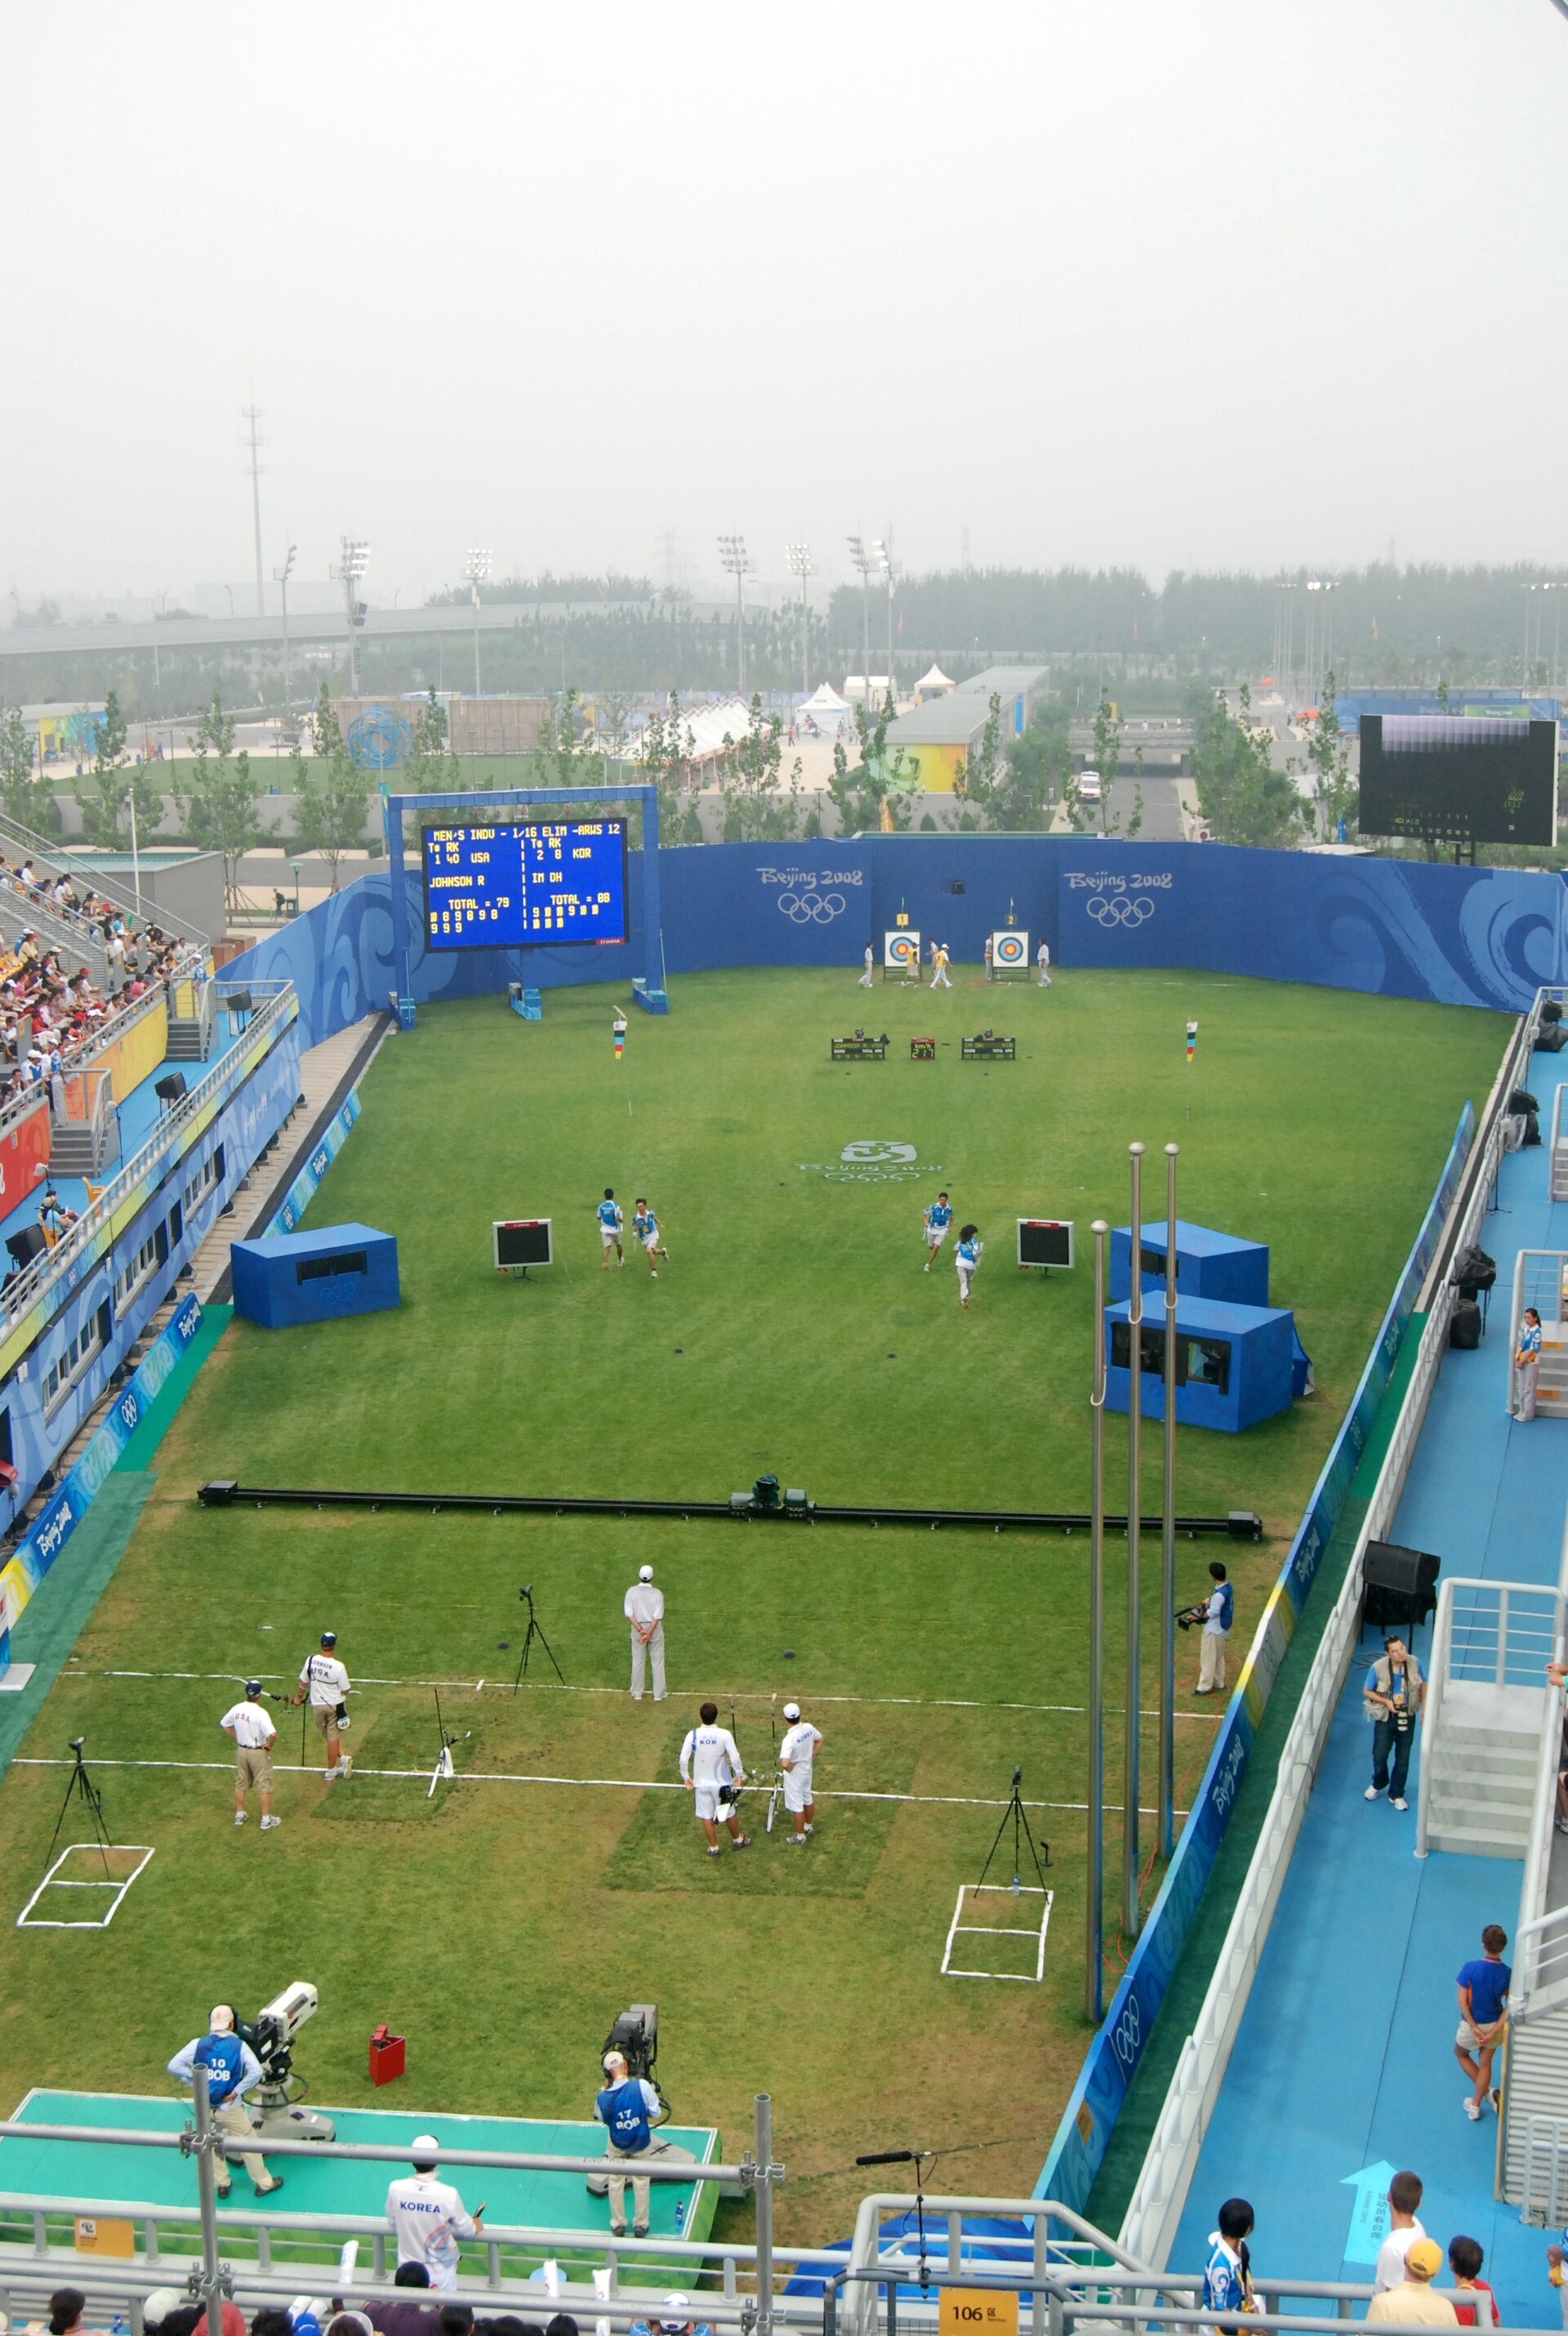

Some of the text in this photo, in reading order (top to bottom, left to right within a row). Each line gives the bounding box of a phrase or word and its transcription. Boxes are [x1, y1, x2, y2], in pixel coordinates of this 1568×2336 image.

[434, 830, 465, 840] MEN'S
[513, 827, 537, 838] 1/16
[542, 826, 567, 836] ELIM
[608, 823, 620, 834] 12
[446, 841, 459, 852] RK
[549, 837, 561, 848] RK
[435, 852, 490, 864] 1 40 USA
[537, 849, 544, 860] 2
[572, 847, 591, 858] KOR
[430, 875, 485, 888] JOHNSON R
[532, 872, 563, 883] IM DH
[755, 867, 863, 889] Beijing 2008
[1062, 871, 1173, 893] Beijing 2008
[448, 898, 479, 910] TOTAL
[497, 897, 510, 907] 79
[550, 894, 580, 905] TOTAL
[597, 892, 610, 903] 88
[455, 910, 462, 921] 9
[479, 909, 486, 921] 9
[532, 907, 540, 917] 9
[568, 905, 576, 916] 9
[1008, 915, 1014, 925] 2
[430, 921, 463, 934] 9 9 9
[912, 1049, 933, 1059] 217
[36, 1522, 62, 1557] Beijing
[1295, 1548, 1315, 1583] Beijing
[310, 1668, 330, 1679] USA
[235, 1713, 251, 1723] USA
[1212, 1765, 1236, 1816] Beijing
[211, 2057, 227, 2068] 10
[617, 2109, 632, 2120] 17
[399, 2201, 441, 2213] KOREA
[952, 2305, 983, 2321] 106
